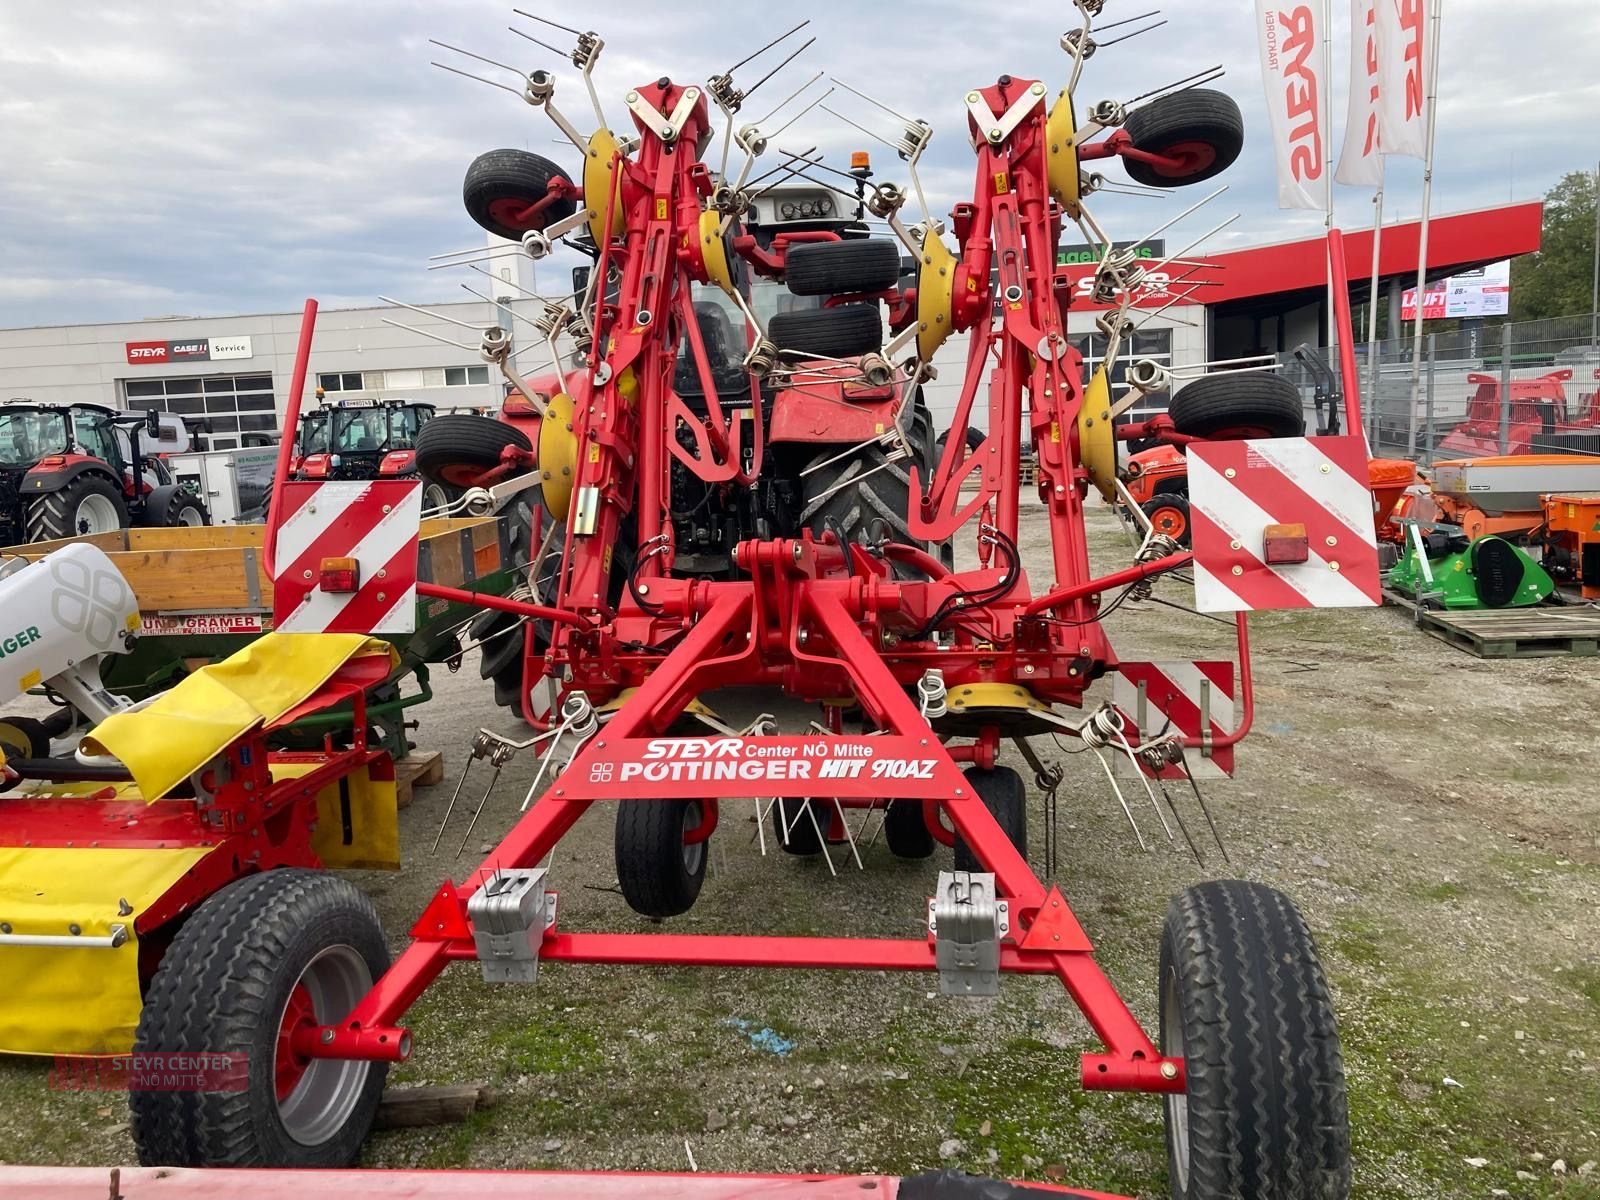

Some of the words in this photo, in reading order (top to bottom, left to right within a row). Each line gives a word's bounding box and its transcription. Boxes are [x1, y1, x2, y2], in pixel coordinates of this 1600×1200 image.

[130, 347, 165, 358] STEYR
[173, 345, 197, 353] CASE
[215, 345, 246, 353] Service
[642, 738, 743, 759] STEYR
[745, 744, 798, 757] Center
[802, 741, 828, 757] NÖ
[834, 744, 873, 757] Mitte
[619, 760, 812, 781] PÖTTINGER
[818, 759, 867, 779] HIT
[871, 759, 939, 779] 910AZ
